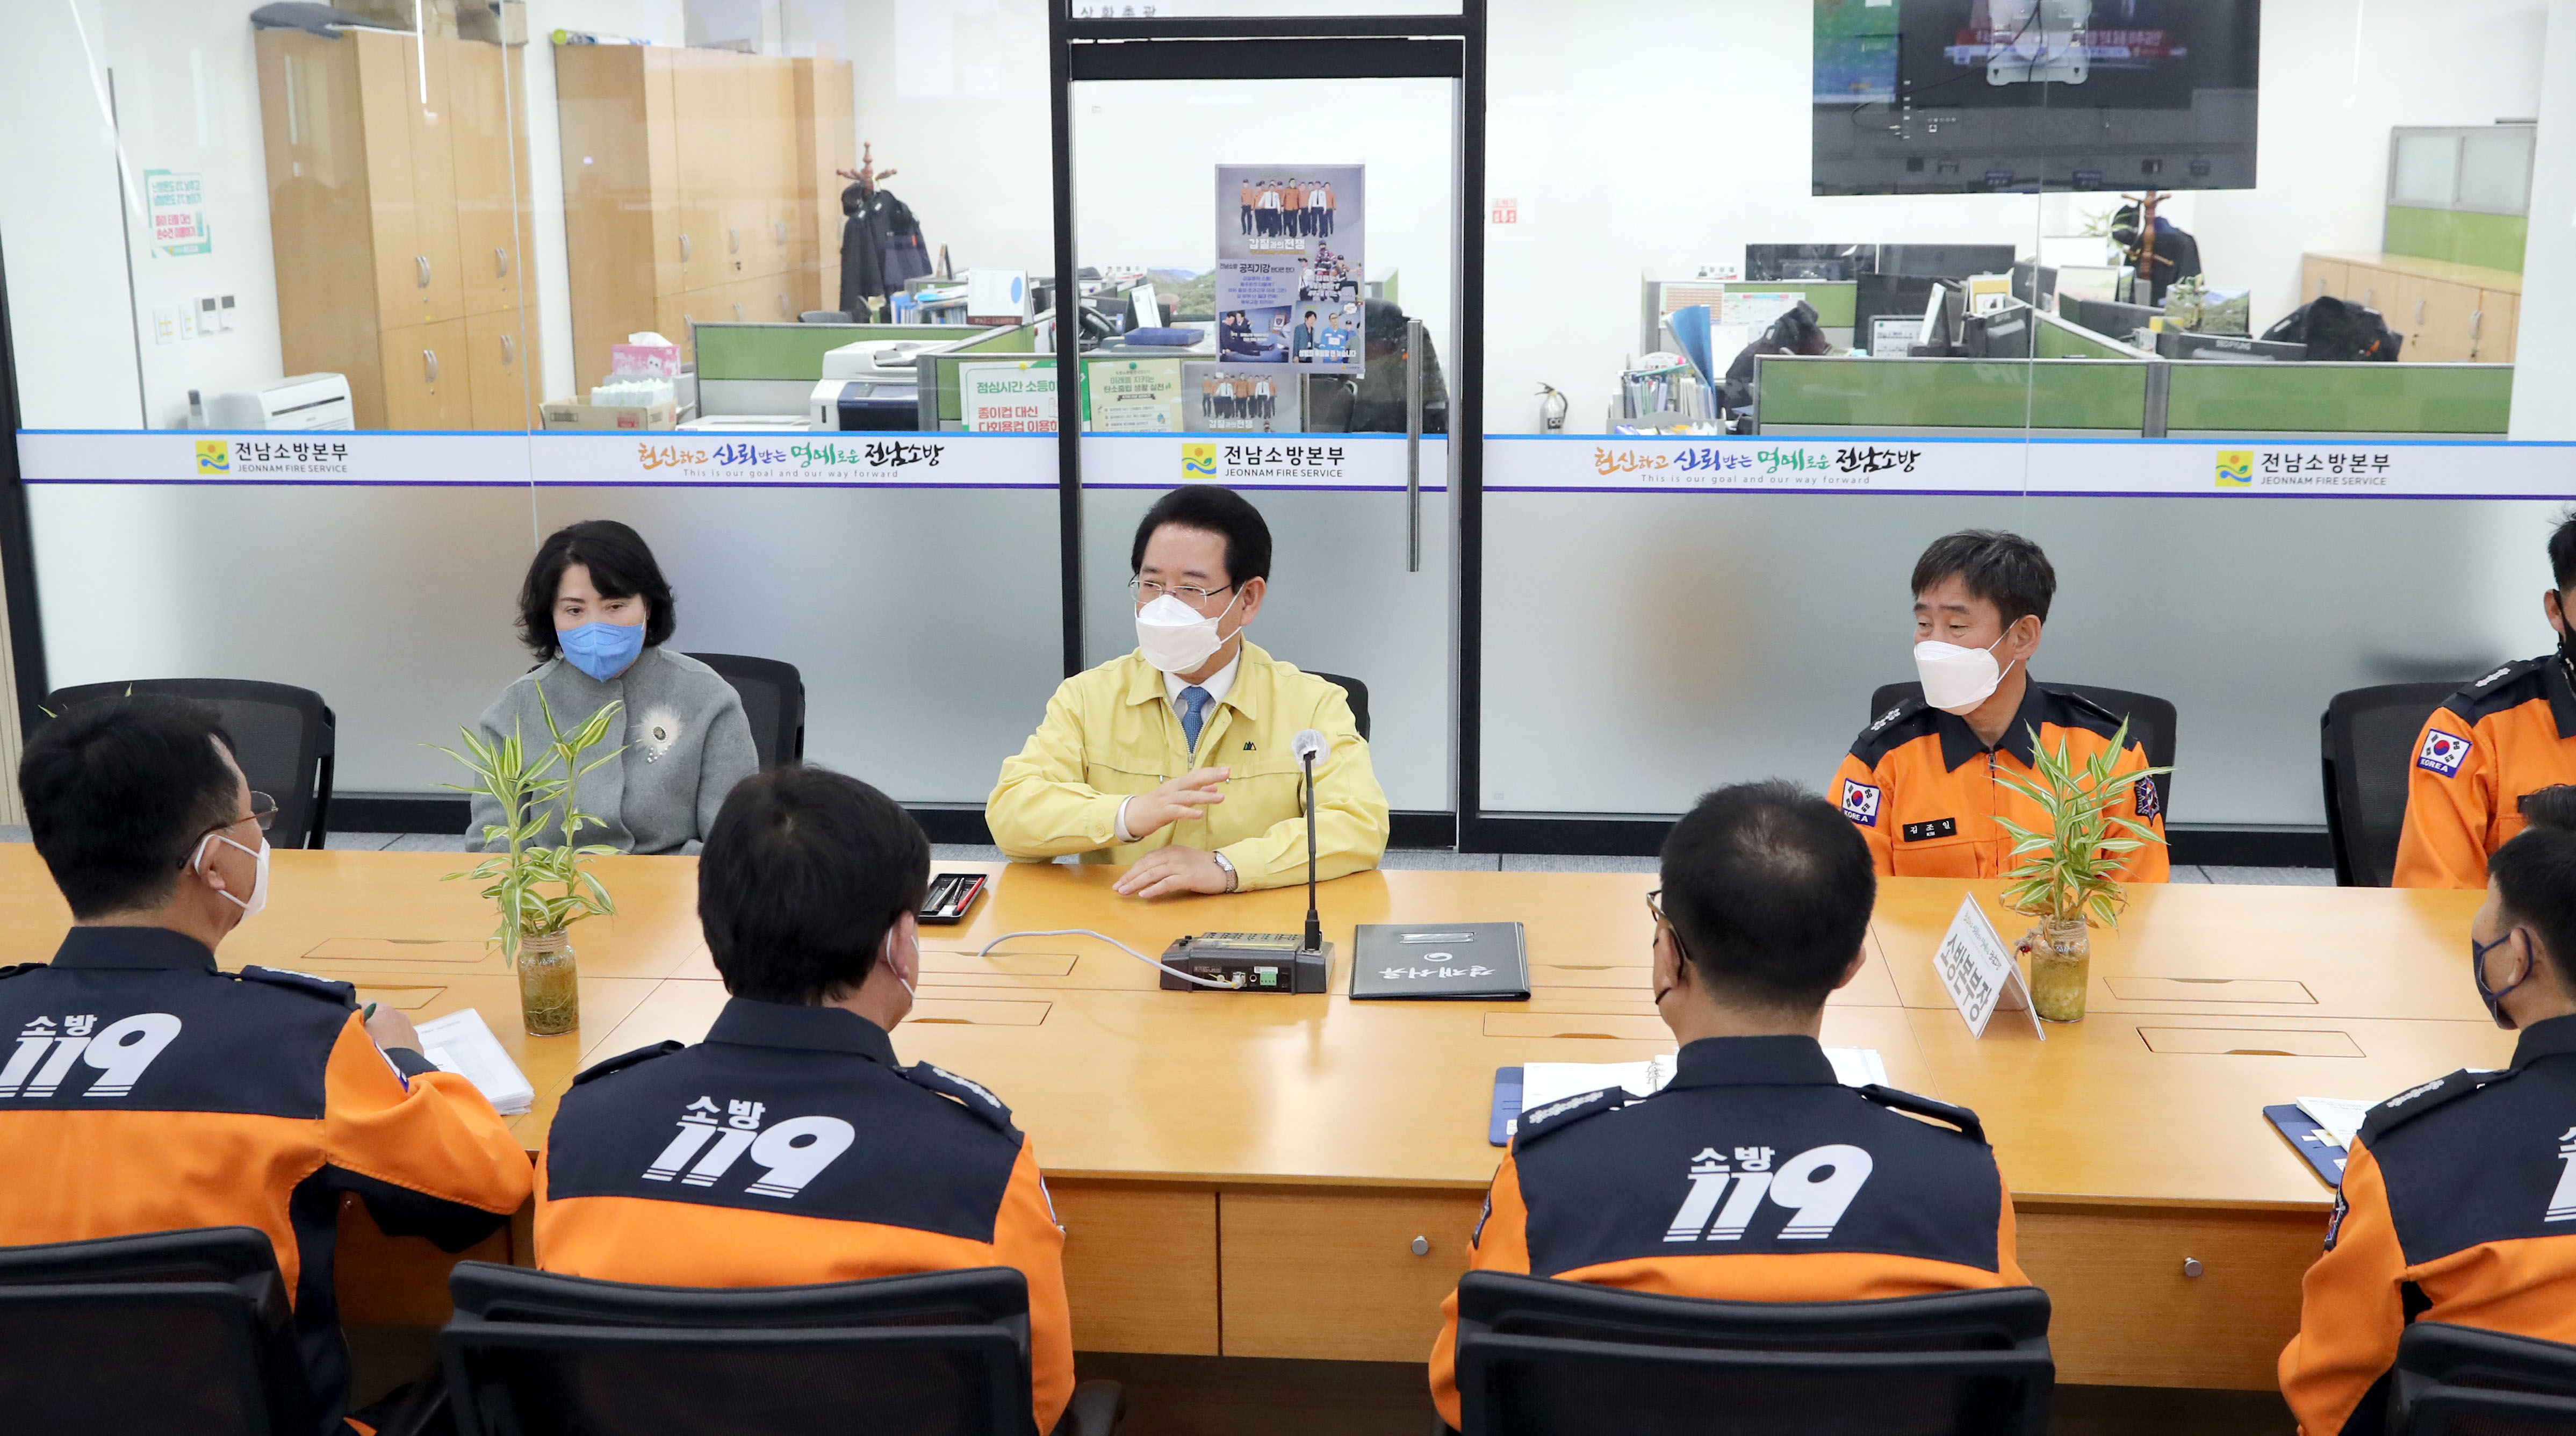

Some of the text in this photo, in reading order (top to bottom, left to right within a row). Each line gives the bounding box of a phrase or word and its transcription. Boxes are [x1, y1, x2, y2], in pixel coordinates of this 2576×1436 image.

[1240, 263, 1270, 273] 공직기강
[977, 381, 1023, 393] 점심시간
[978, 406, 1038, 419] 종이컵 대신
[235, 442, 348, 461] 전남소방본부
[638, 441, 944, 470] 헌신하고 신뢰받는 명예로운 전남소방
[1224, 446, 1344, 466] 전남소방본부
[1595, 446, 1921, 475] 헌신하고 신뢰받는 명예로운 전남소방
[2261, 453, 2390, 473] 전남소방본부
[750, 469, 773, 478] goal
[1225, 469, 1343, 477] JEONNAM FIRE SERVICE
[1711, 476, 1737, 484] goal
[2342, 477, 2386, 485] SERVICE
[2420, 758, 2448, 772] KOREA
[1844, 810, 1868, 822] KOREA
[1383, 965, 1495, 979] 결재서류
[1940, 934, 1992, 1022] 소방본부장
[21, 1014, 97, 1036] 소방
[0, 1013, 182, 1098] 119
[681, 1096, 766, 1130] 소방
[642, 1116, 855, 1198] 119
[1691, 1146, 1775, 1173] 소방
[1663, 1144, 1873, 1242] 119
